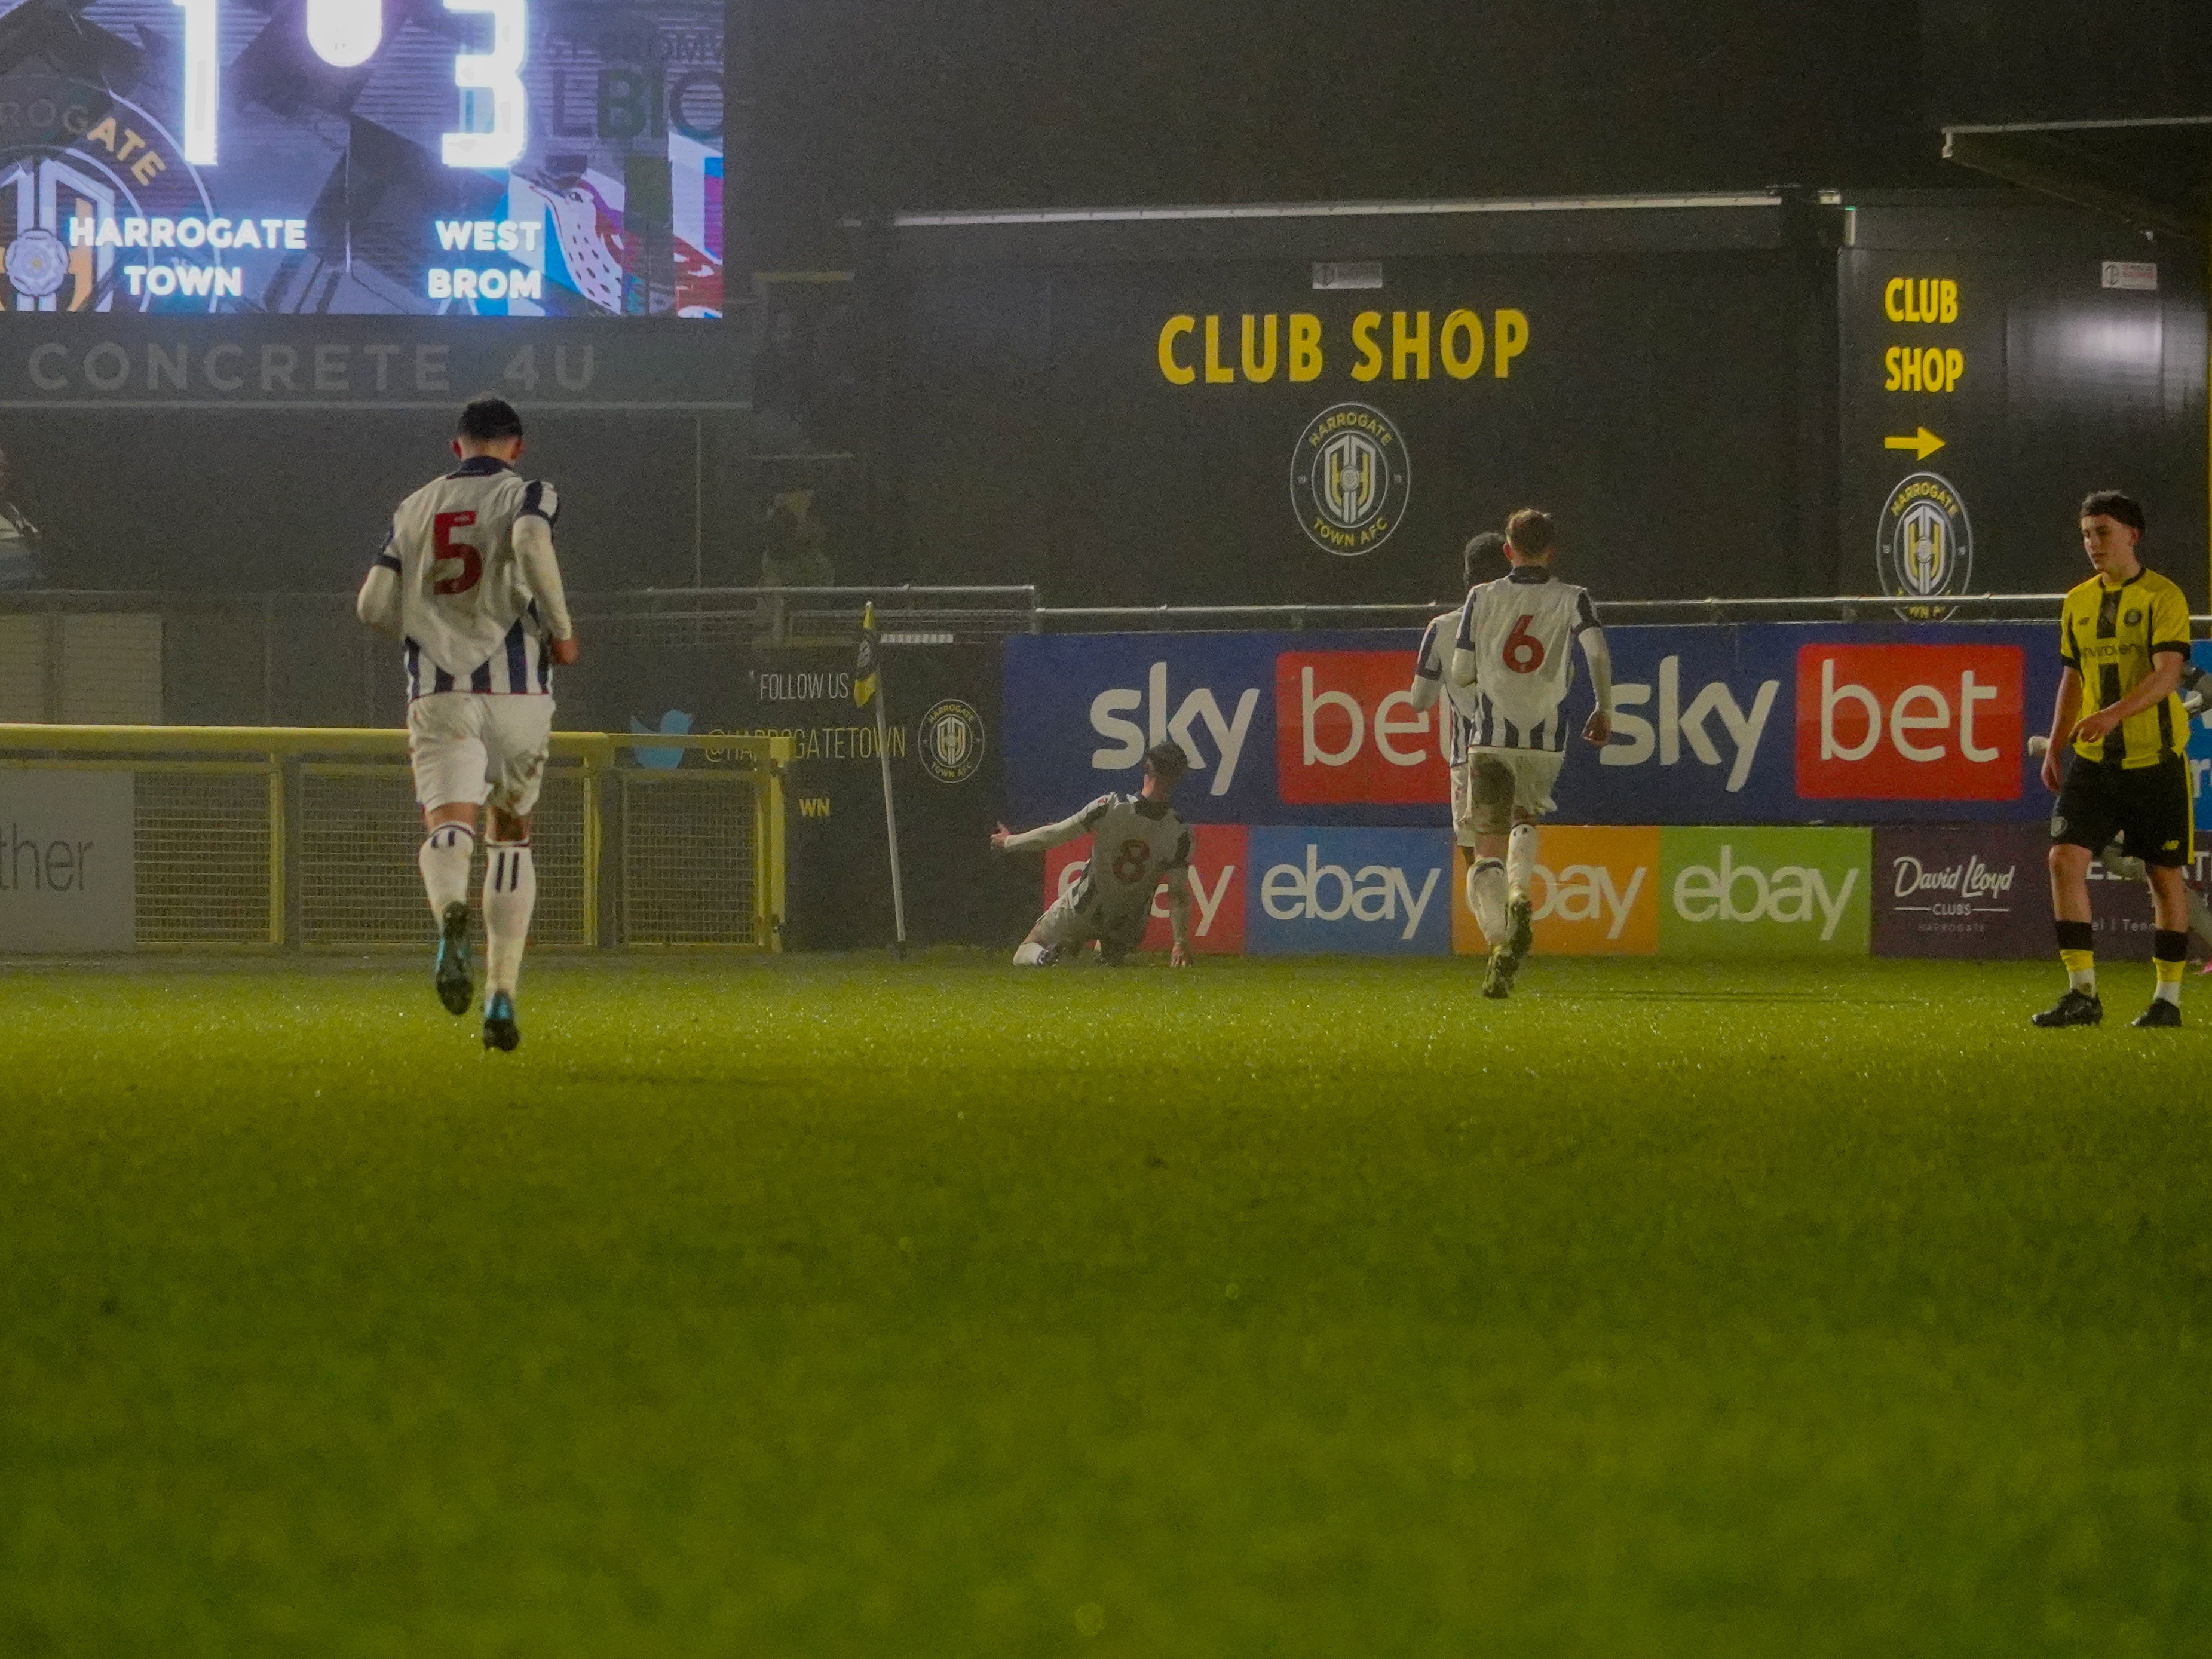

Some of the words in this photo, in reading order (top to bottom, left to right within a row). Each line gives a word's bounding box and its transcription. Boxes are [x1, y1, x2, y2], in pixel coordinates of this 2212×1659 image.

[173, 0, 217, 166] 1
[442, 0, 528, 168] 3
[69, 217, 308, 249] HARROGATE
[435, 220, 542, 252] WEST
[124, 265, 243, 296] TOWN
[428, 268, 541, 299] BROM
[1884, 276, 1959, 324] CLUB
[29, 341, 450, 391] CONCRETE
[503, 343, 595, 392] 4U
[1158, 312, 1324, 385] CLUB
[1350, 308, 1530, 382] SHOP
[1884, 346, 1965, 392] SHOP
[1309, 412, 1394, 447] HARROGATE
[1891, 482, 1959, 518] HARROGATE
[433, 510, 483, 595] 5
[1313, 517, 1355, 547] TOWN
[1361, 517, 1389, 545] AFC
[1502, 614, 1545, 674] 6
[759, 673, 823, 700] FOLLOW
[828, 673, 849, 700] US
[1090, 661, 1260, 796] sky
[1600, 655, 1779, 792] sky
[1820, 658, 2000, 763] bet
[1111, 832, 1151, 877] 8
[1893, 855, 1963, 897] David
[1962, 854, 2016, 899] Lloyd
[1261, 844, 1442, 940] ebay
[1674, 844, 1859, 941] ebay
[1932, 903, 1971, 916] CLUBS
